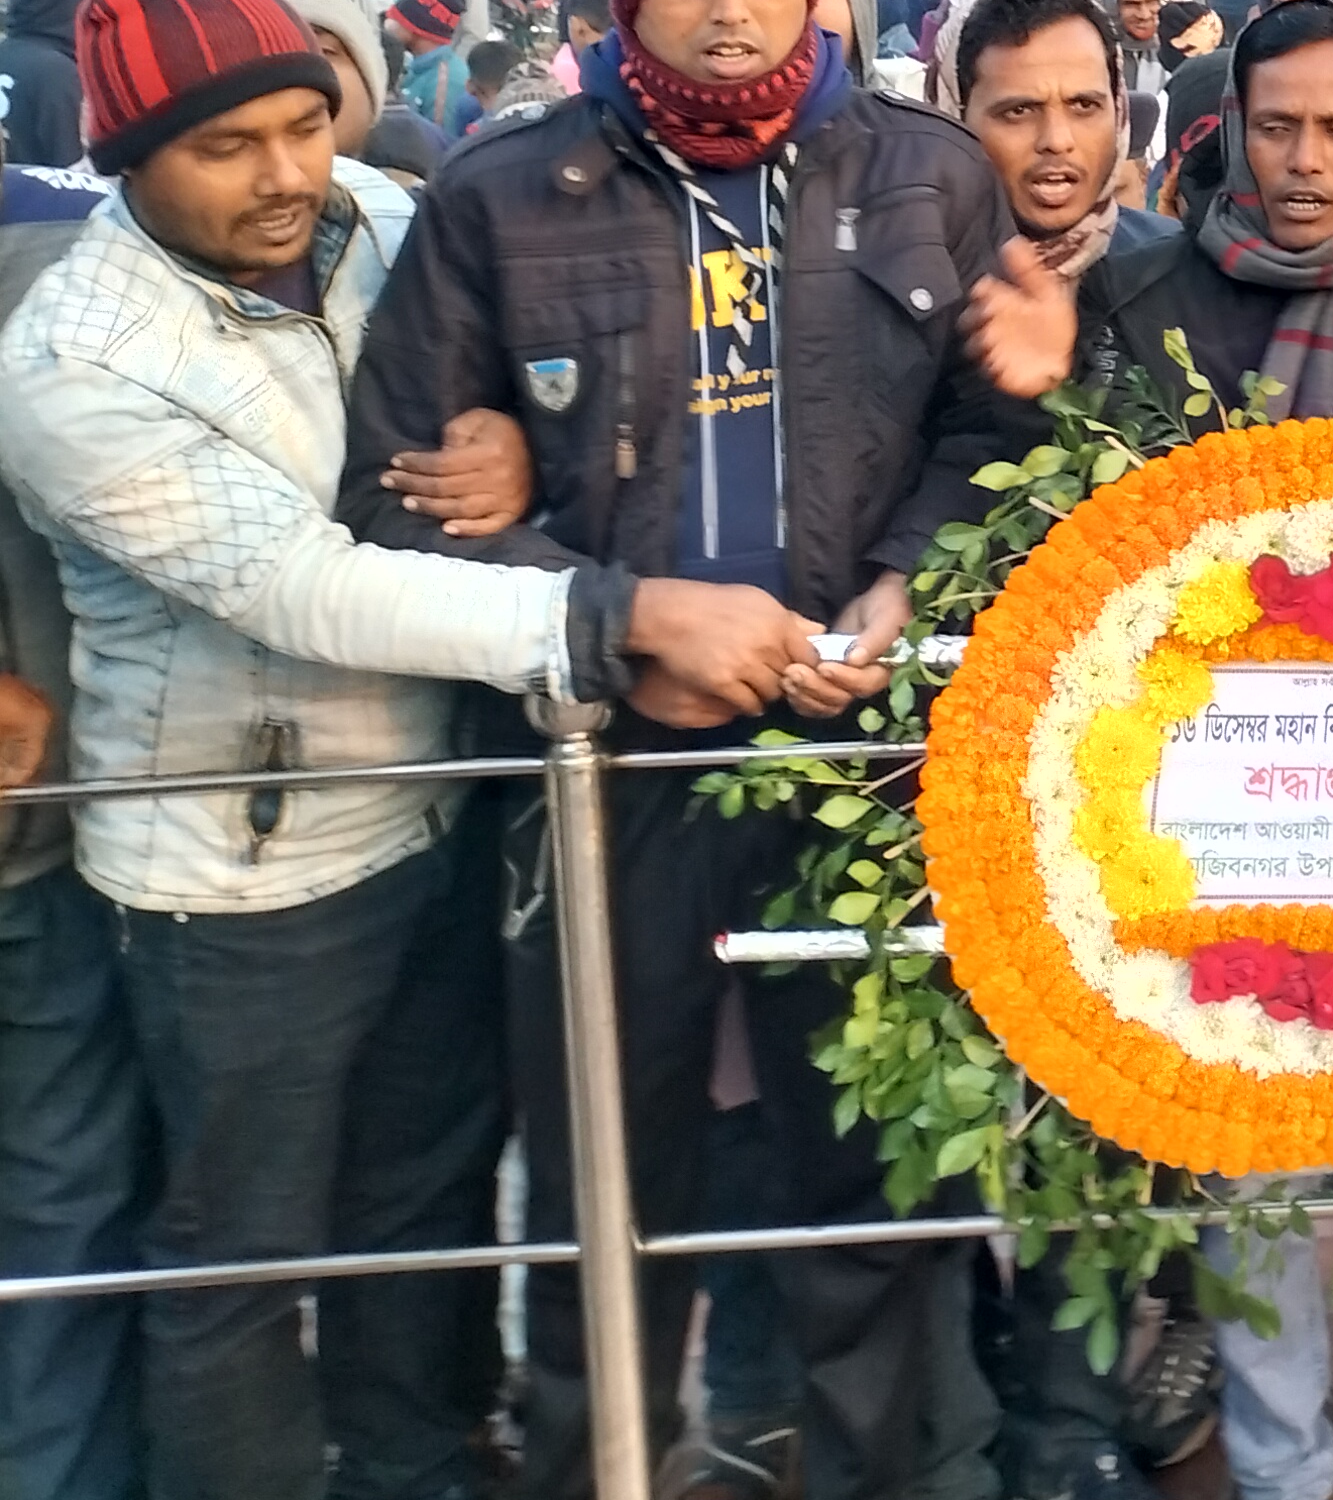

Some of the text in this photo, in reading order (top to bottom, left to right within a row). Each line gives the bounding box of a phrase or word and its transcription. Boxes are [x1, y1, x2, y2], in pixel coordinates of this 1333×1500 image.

[1204, 702, 1270, 744] ডিসেম্বর
[1275, 712, 1318, 745] মহান
[1160, 820, 1248, 841] বাংলাদেশ
[1254, 815, 1331, 841] আওয়ামী
